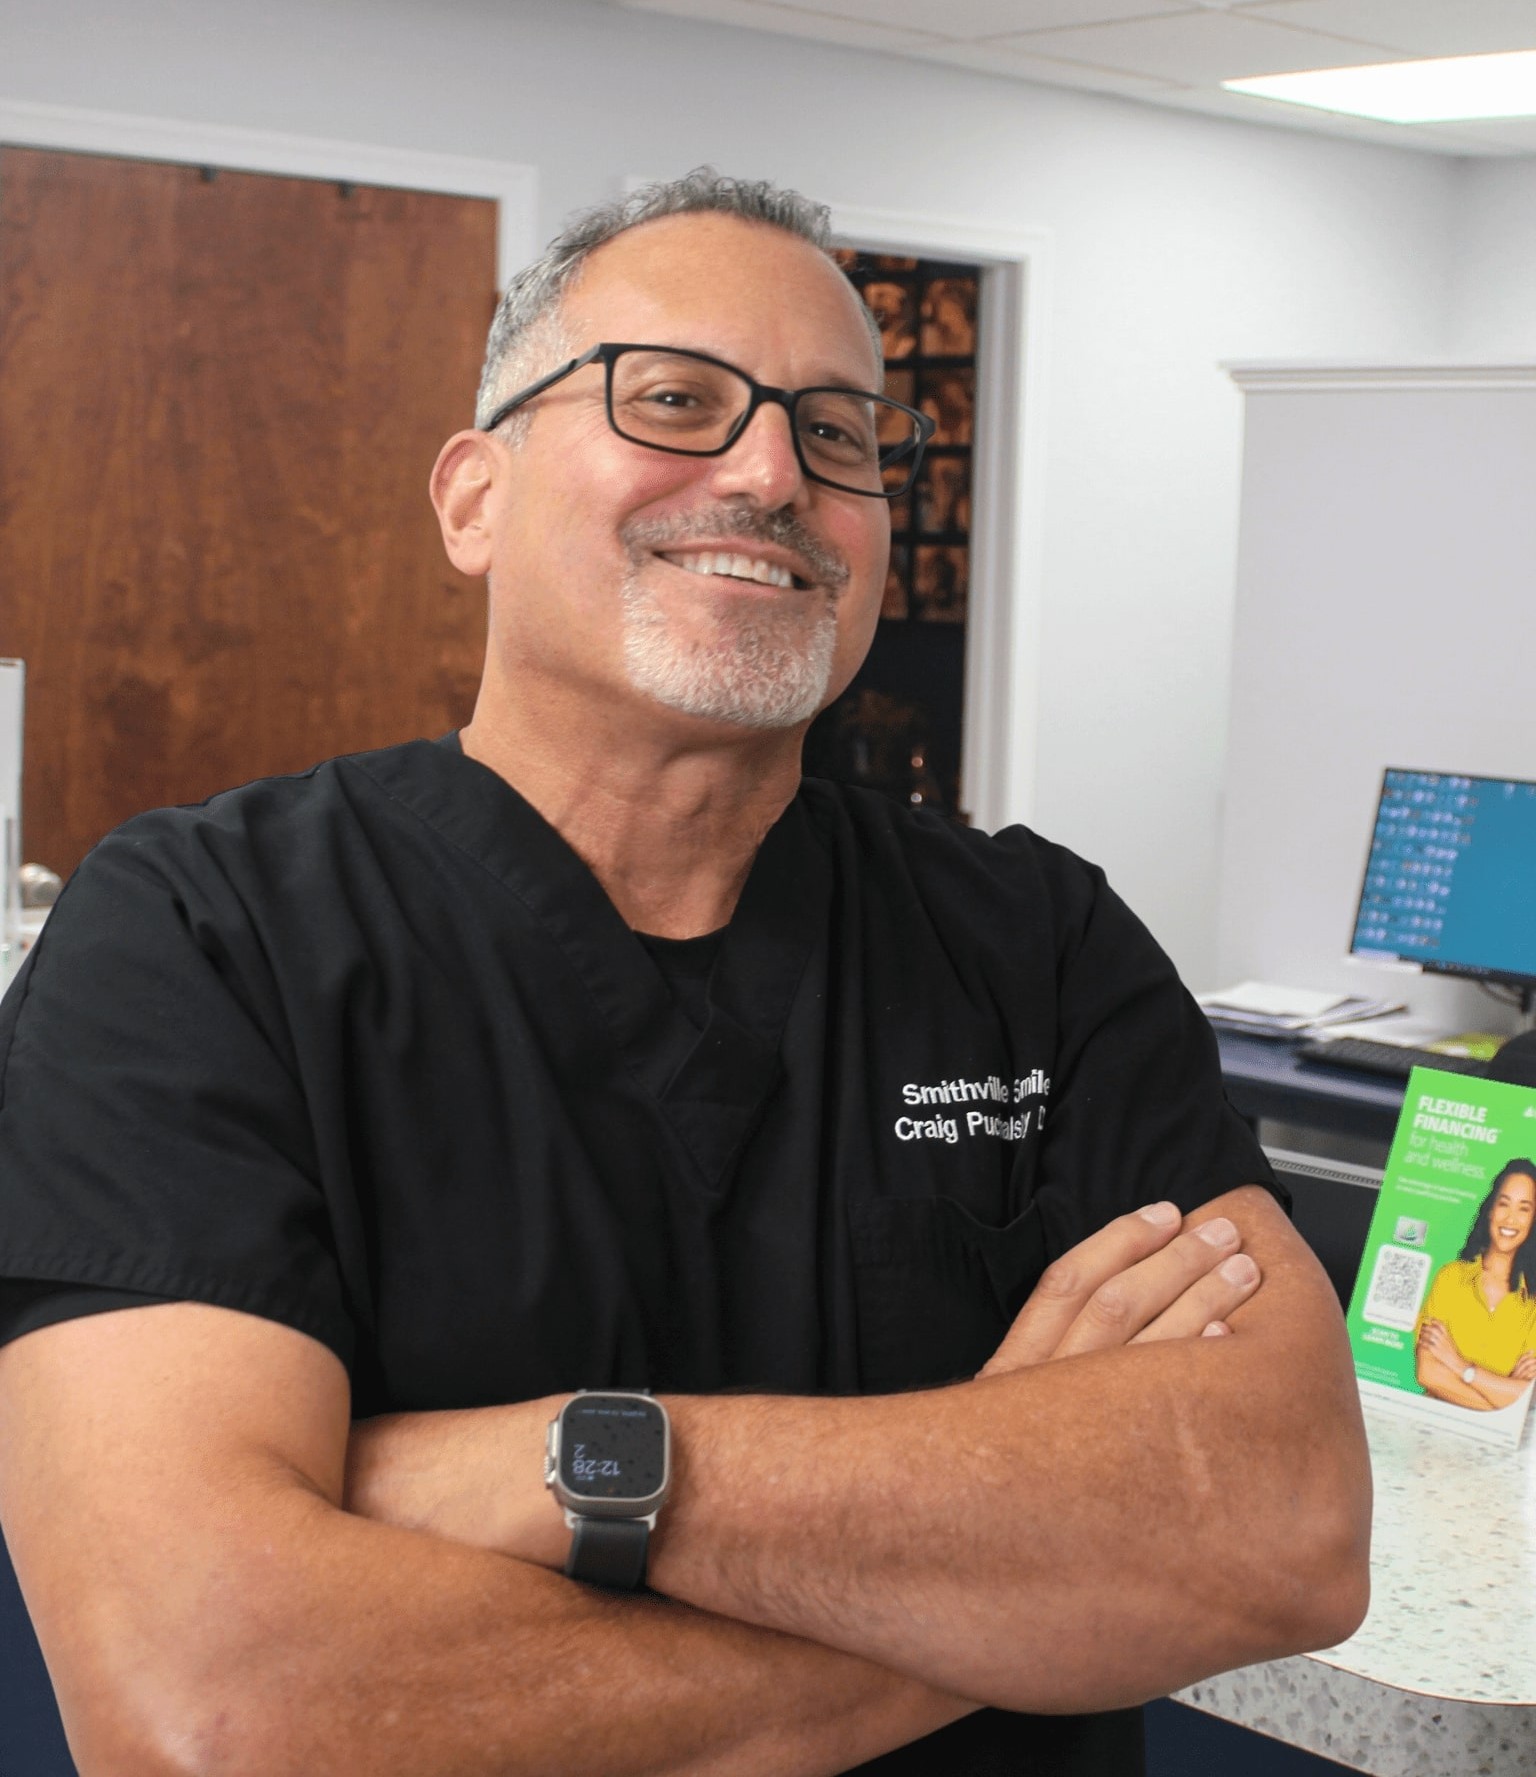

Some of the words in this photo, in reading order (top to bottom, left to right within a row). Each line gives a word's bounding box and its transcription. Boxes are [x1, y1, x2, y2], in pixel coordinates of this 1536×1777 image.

[902, 1076, 1008, 1105] Smithville
[1419, 1095, 1487, 1123] FLEXIBLE
[895, 1114, 958, 1143] Craig
[1413, 1113, 1500, 1144] FINANCING
[1409, 1131, 1427, 1148] for
[1429, 1135, 1469, 1157] health
[1404, 1151, 1430, 1167] and
